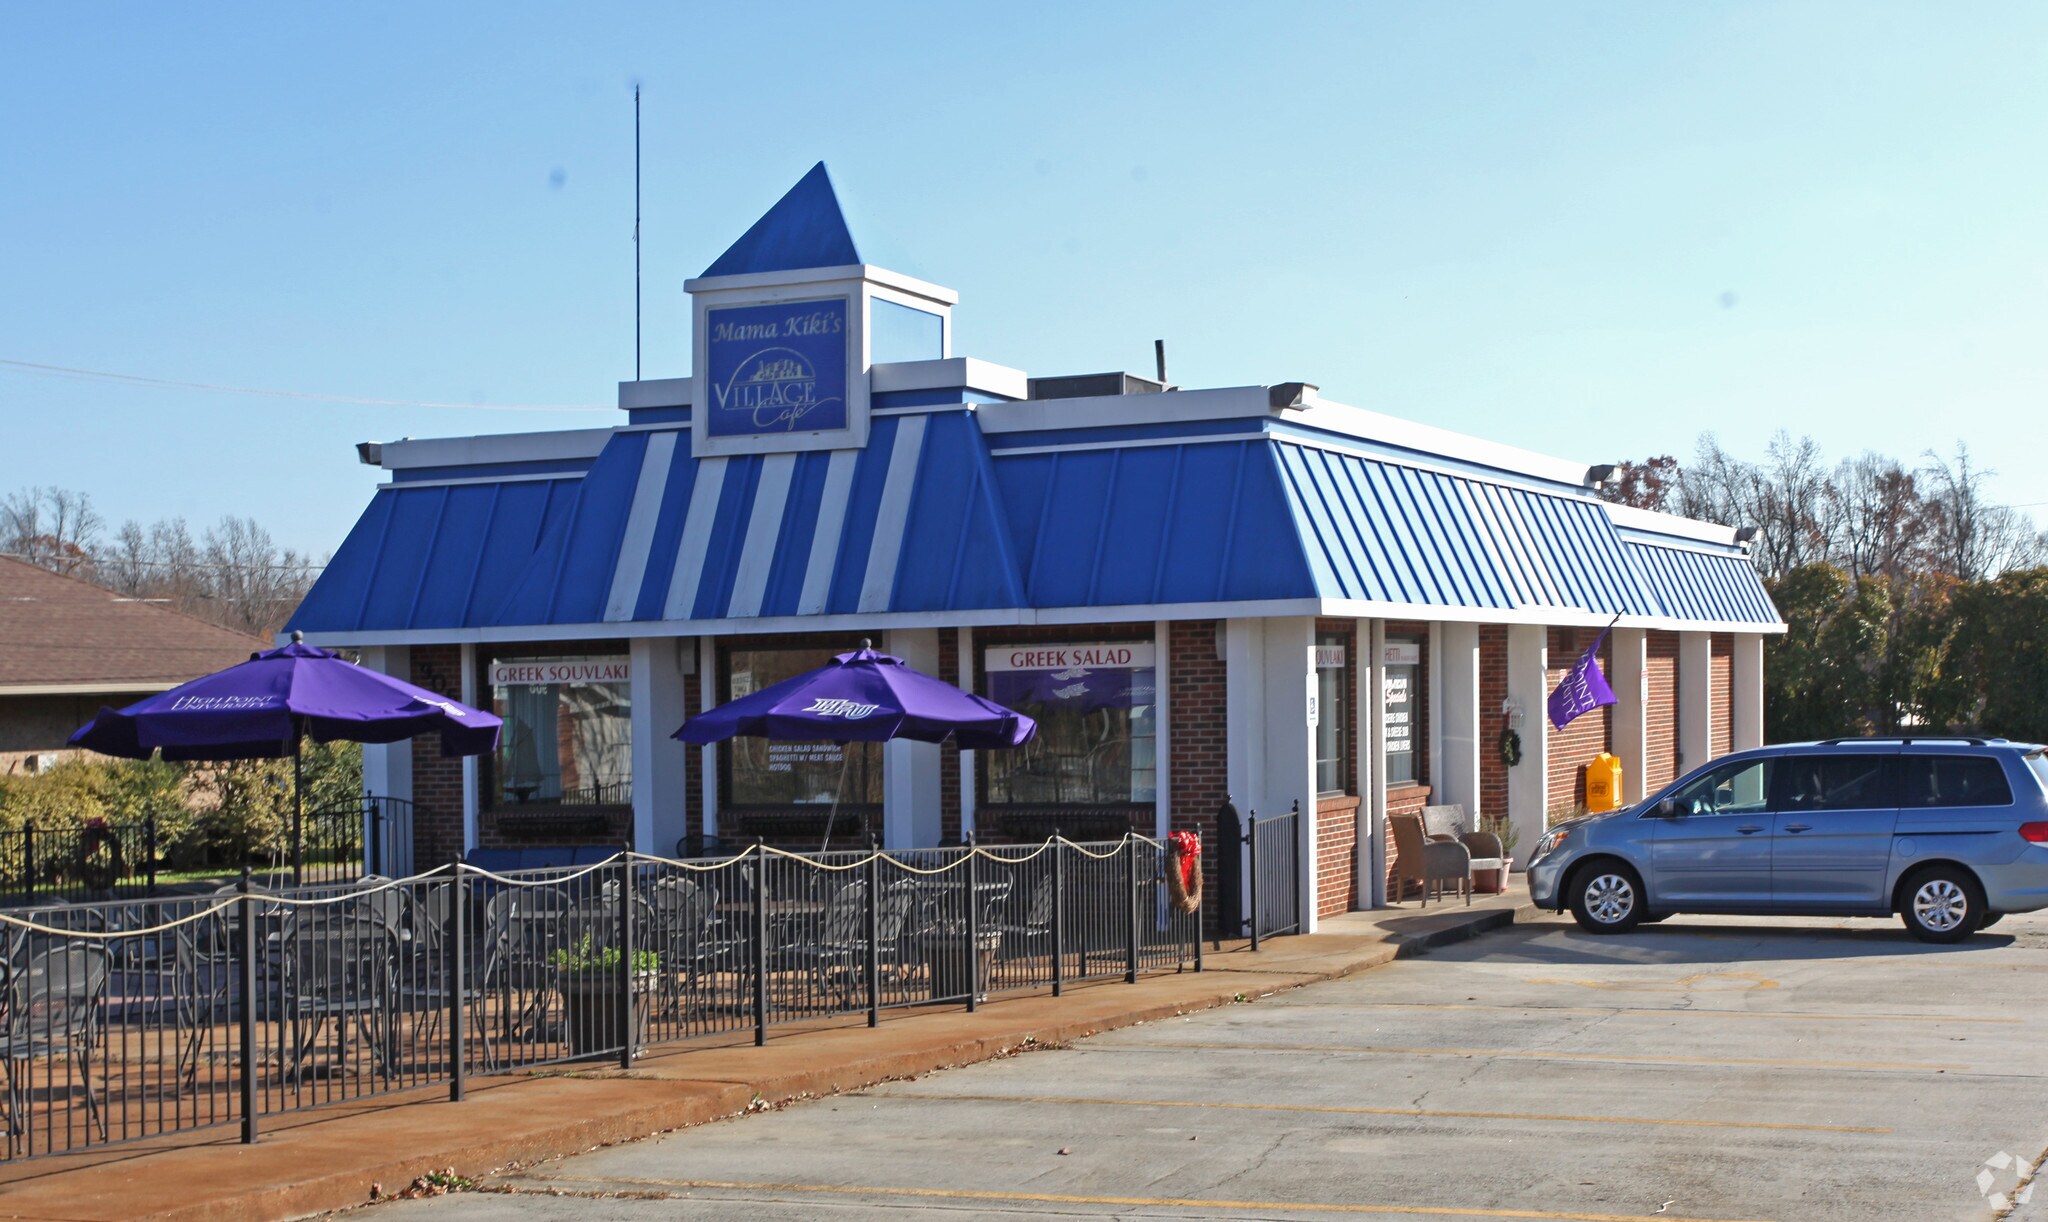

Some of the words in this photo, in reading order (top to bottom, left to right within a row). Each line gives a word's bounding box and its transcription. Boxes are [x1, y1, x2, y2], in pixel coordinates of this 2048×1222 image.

[713, 321, 778, 343] Mama
[783, 312, 843, 337] Kiki's
[712, 380, 817, 410] VILLAGE
[1010, 651, 1068, 669] GREEK
[1073, 648, 1132, 666] SALAD
[495, 666, 545, 683] GREEK
[549, 664, 630, 681] SOUVLAKI
